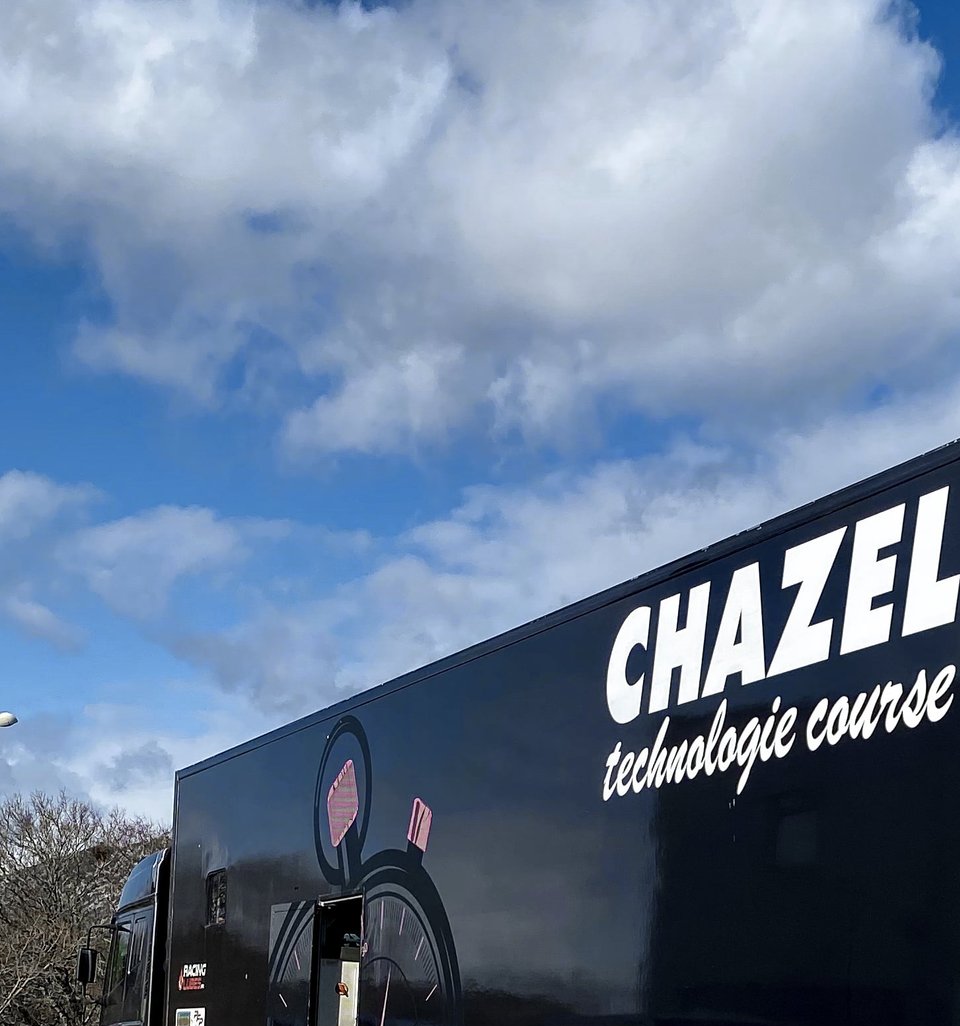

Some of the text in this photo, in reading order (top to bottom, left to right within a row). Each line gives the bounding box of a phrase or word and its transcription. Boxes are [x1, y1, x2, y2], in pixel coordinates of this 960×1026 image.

[602, 663, 957, 802] technologie course
[183, 963, 207, 977] RACING
